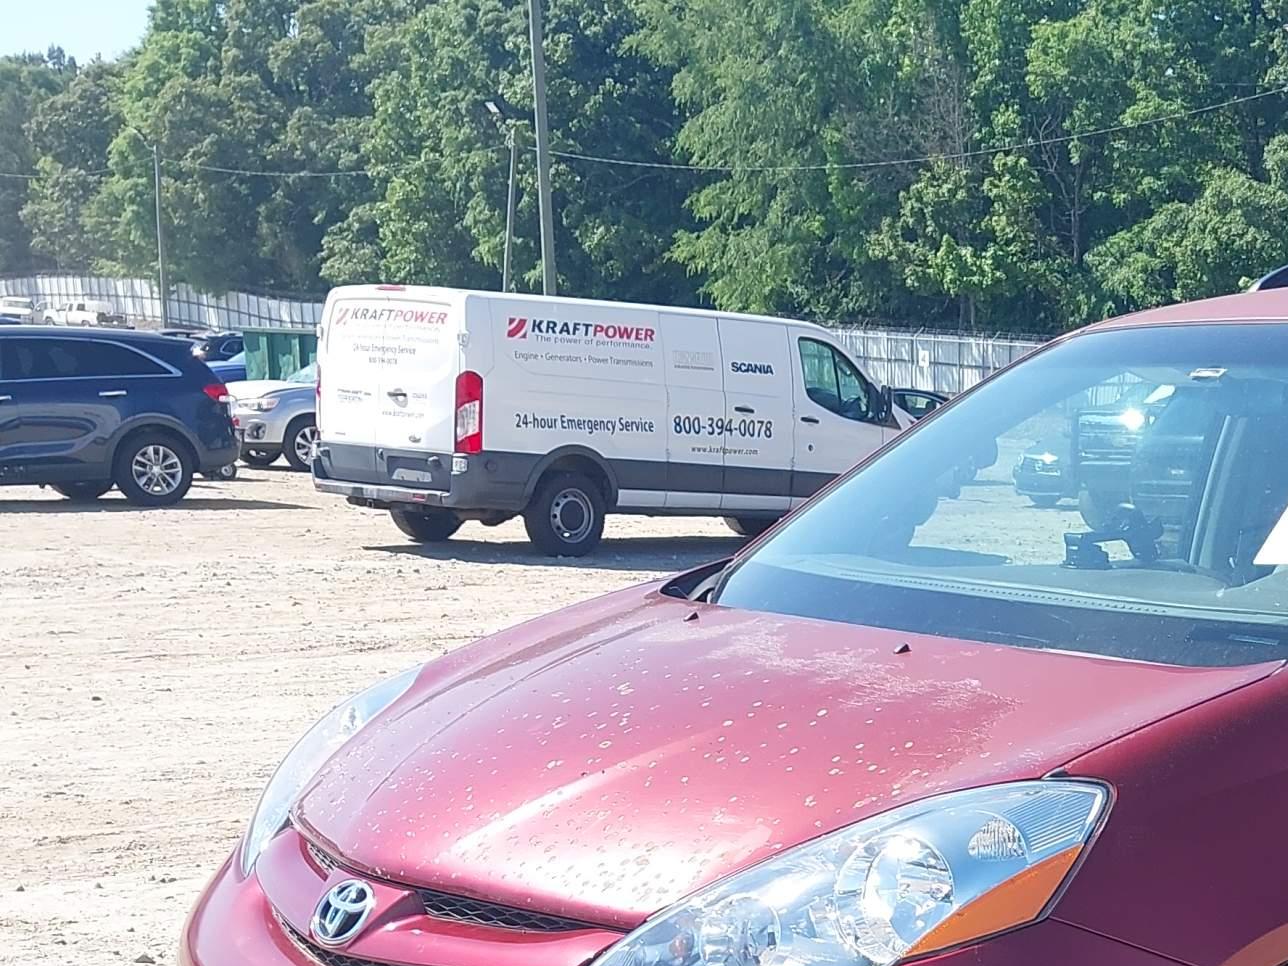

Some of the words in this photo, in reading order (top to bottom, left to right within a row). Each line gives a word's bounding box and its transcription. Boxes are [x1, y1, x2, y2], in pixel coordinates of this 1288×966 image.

[350, 307, 448, 325] KRAFTPOWER
[531, 318, 656, 342] KRAFTPOWER
[535, 334, 551, 343] The
[554, 337, 581, 346] power
[584, 337, 594, 346] of
[514, 350, 539, 362] Engine
[545, 352, 582, 363] Generators
[588, 356, 609, 365] Power
[610, 356, 653, 368] Transmissions
[731, 361, 774, 375] SCANIA
[515, 412, 558, 429] 24-hour
[560, 414, 617, 435] Emergency
[619, 416, 654, 433] Service
[673, 415, 773, 439] 800-394-0078
